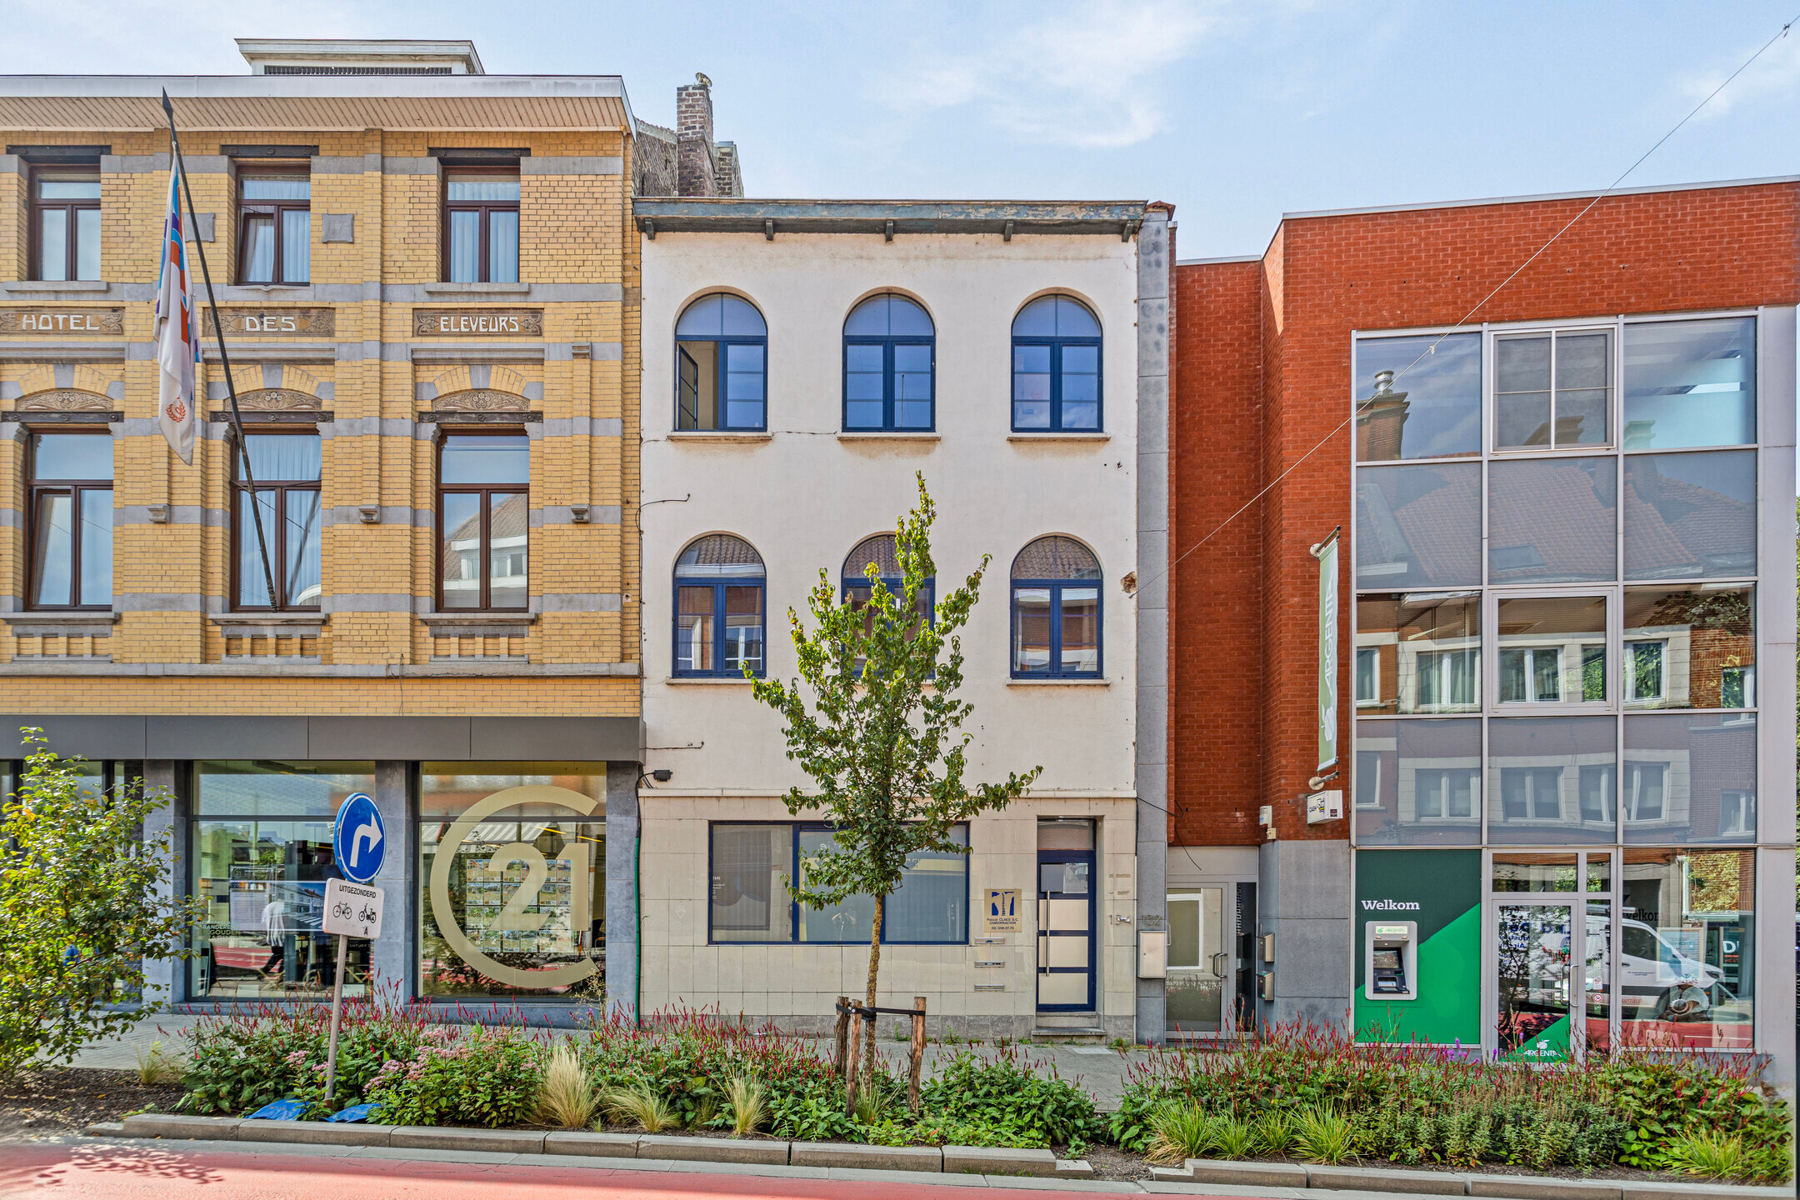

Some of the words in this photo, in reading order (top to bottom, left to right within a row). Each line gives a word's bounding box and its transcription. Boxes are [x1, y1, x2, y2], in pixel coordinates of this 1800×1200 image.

[21, 314, 100, 331] HOTEL
[245, 316, 296, 332] DES
[440, 316, 519, 332] ELEVEURS
[1324, 570, 1334, 697] ARGENTA
[338, 884, 377, 899] UITGEZONDERD
[1361, 899, 1420, 910] Welkom
